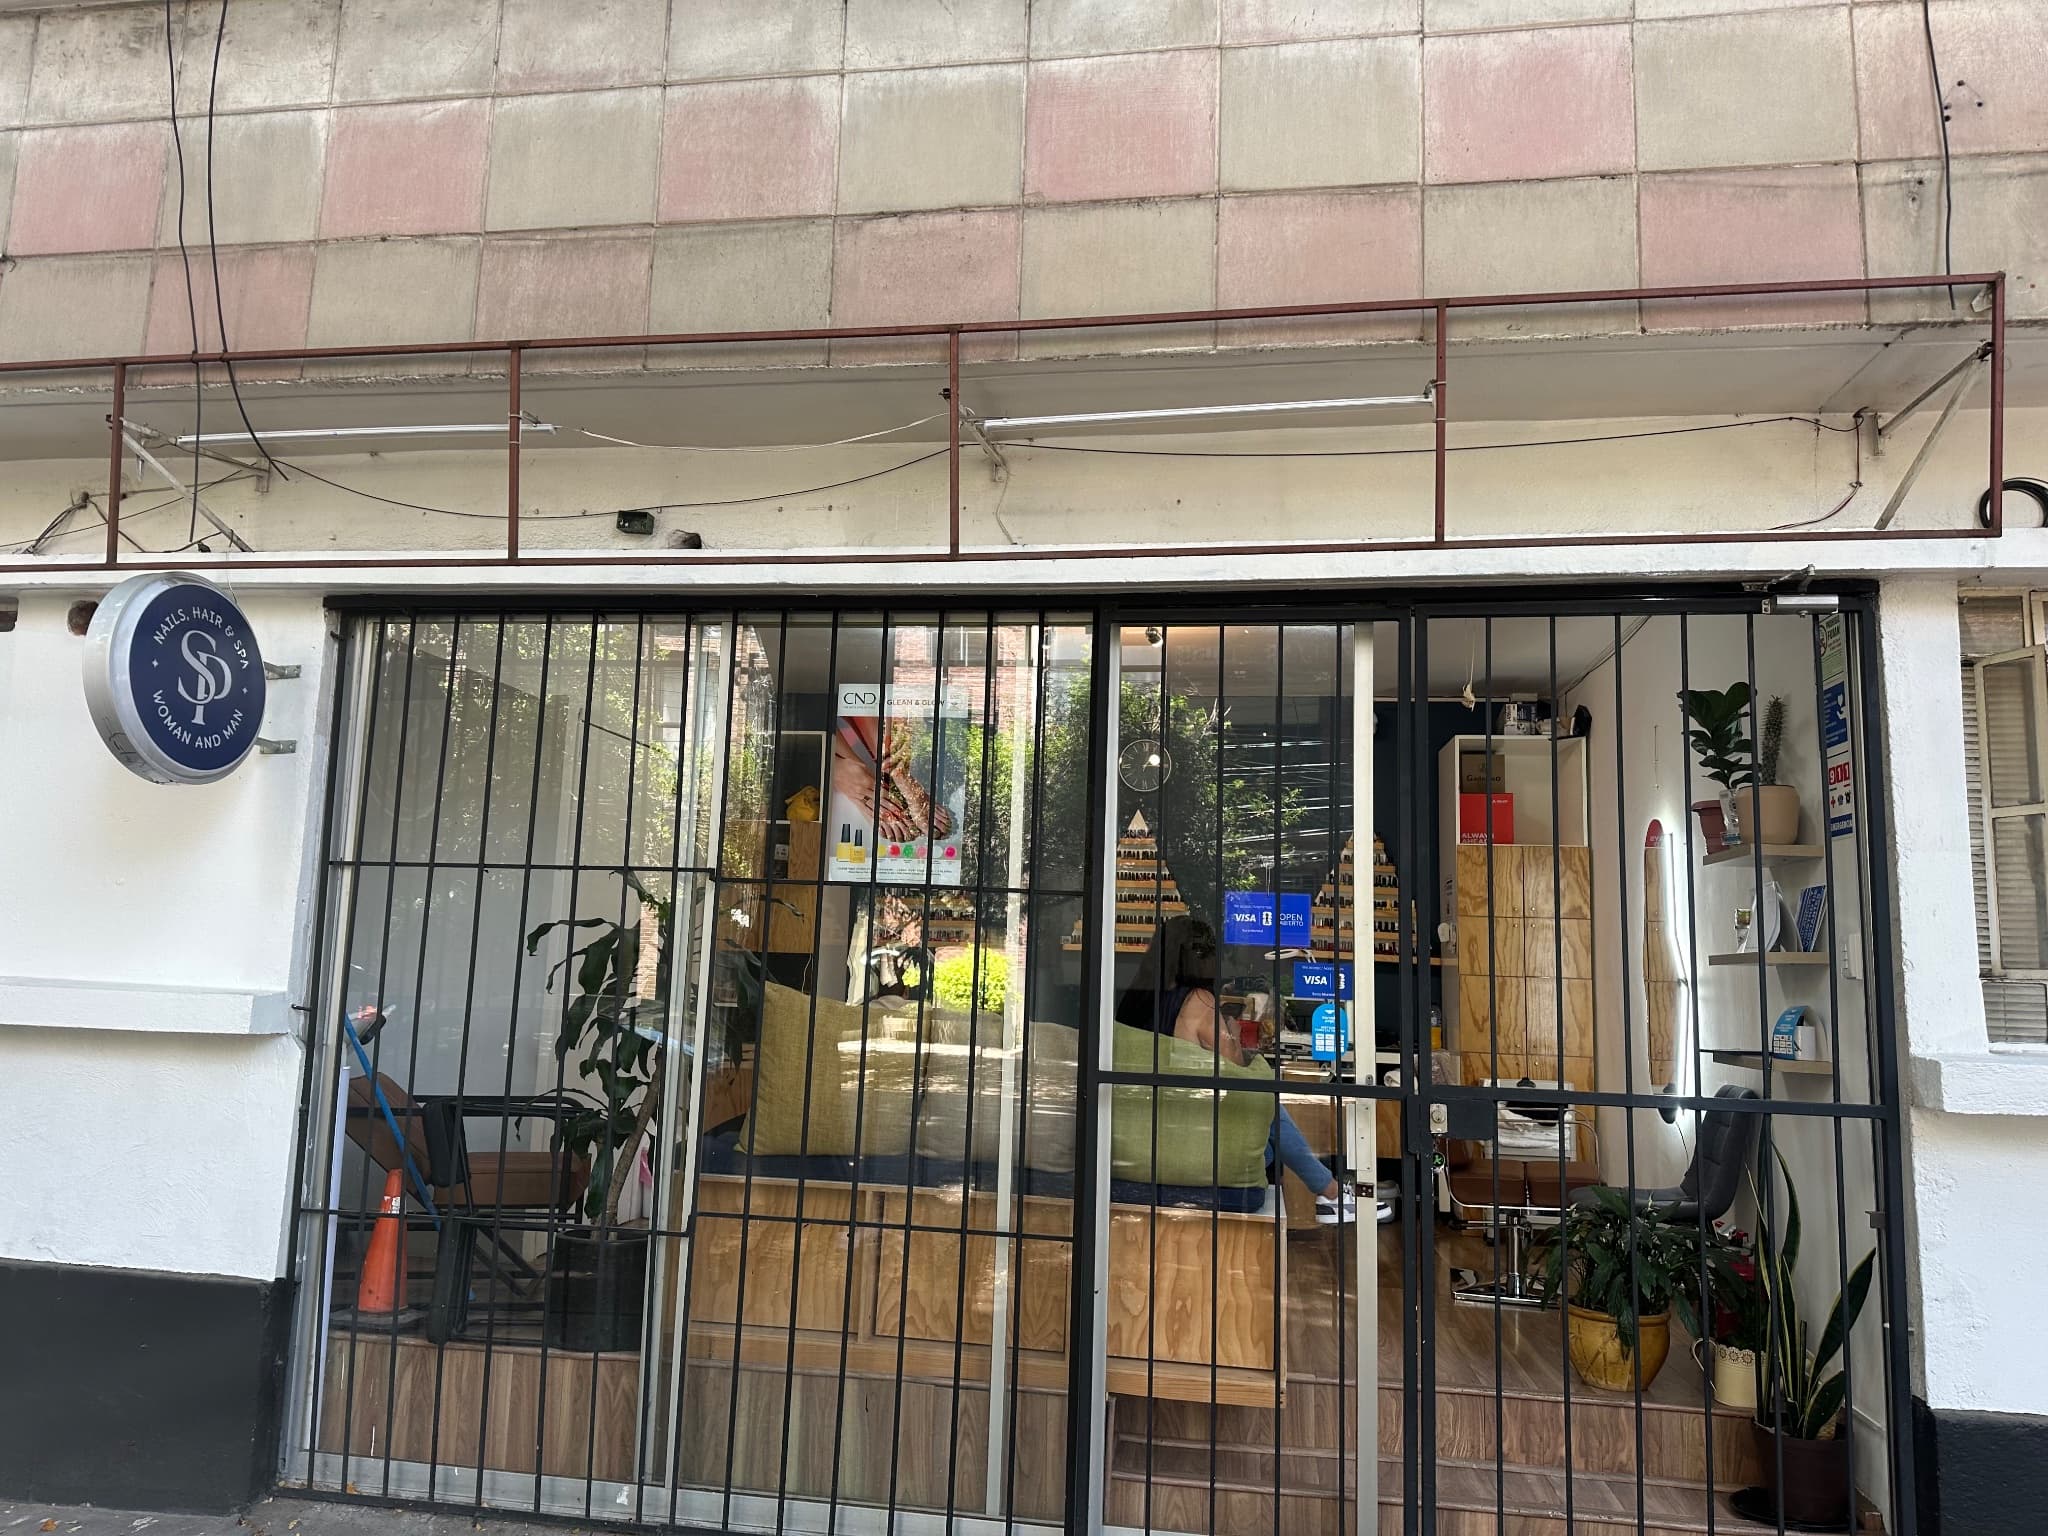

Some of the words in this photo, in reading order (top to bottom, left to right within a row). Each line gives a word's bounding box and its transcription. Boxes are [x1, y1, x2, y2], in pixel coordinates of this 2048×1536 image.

[153, 608, 190, 645] NAILS,
[192, 606, 222, 629] HAIR
[233, 639, 249, 670] SPA
[843, 692, 877, 705] CND
[152, 689, 191, 745] WOMAN
[195, 734, 221, 749] AND
[222, 708, 245, 739] MAN
[1829, 763, 1850, 784] 911
[1232, 913, 1257, 922] VISA
[1279, 913, 1303, 921] OPEN
[1302, 975, 1328, 985] VISA
